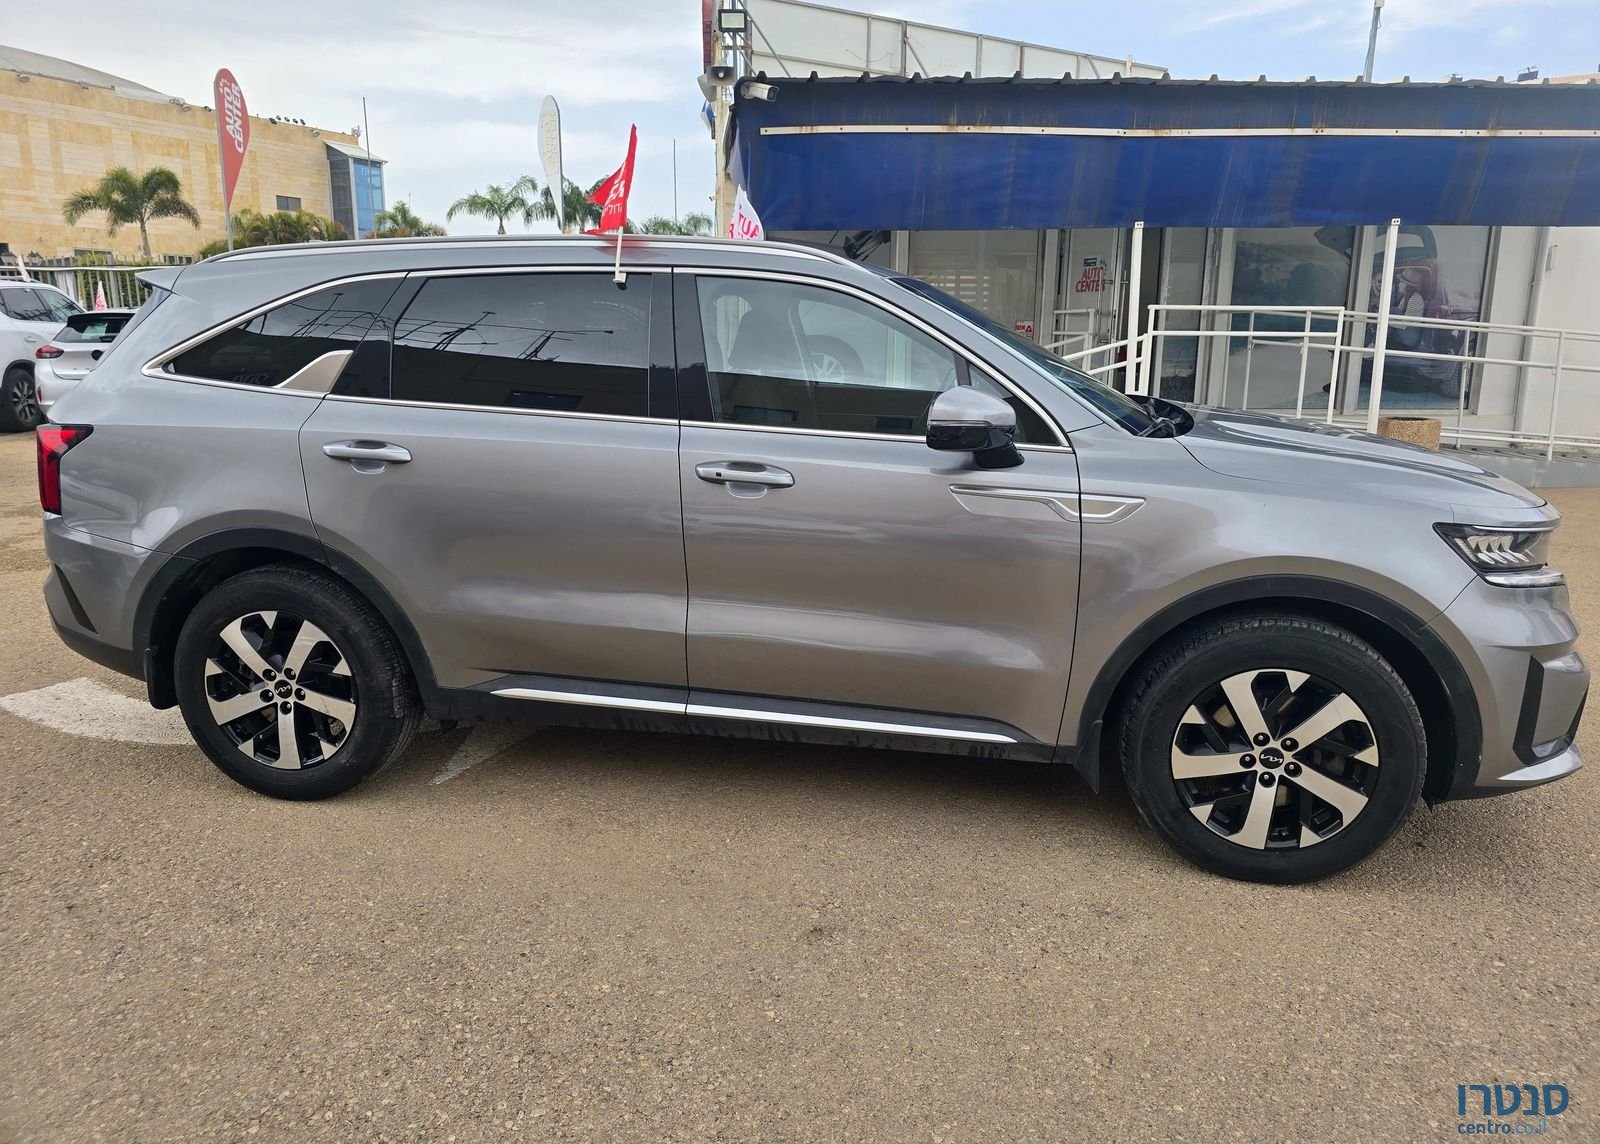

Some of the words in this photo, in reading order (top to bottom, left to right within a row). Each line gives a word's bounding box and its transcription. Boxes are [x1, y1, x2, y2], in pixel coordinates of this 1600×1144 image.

[224, 86, 236, 138] AUTO
[232, 83, 244, 153] CENTER
[1081, 266, 1104, 280] AUTO
